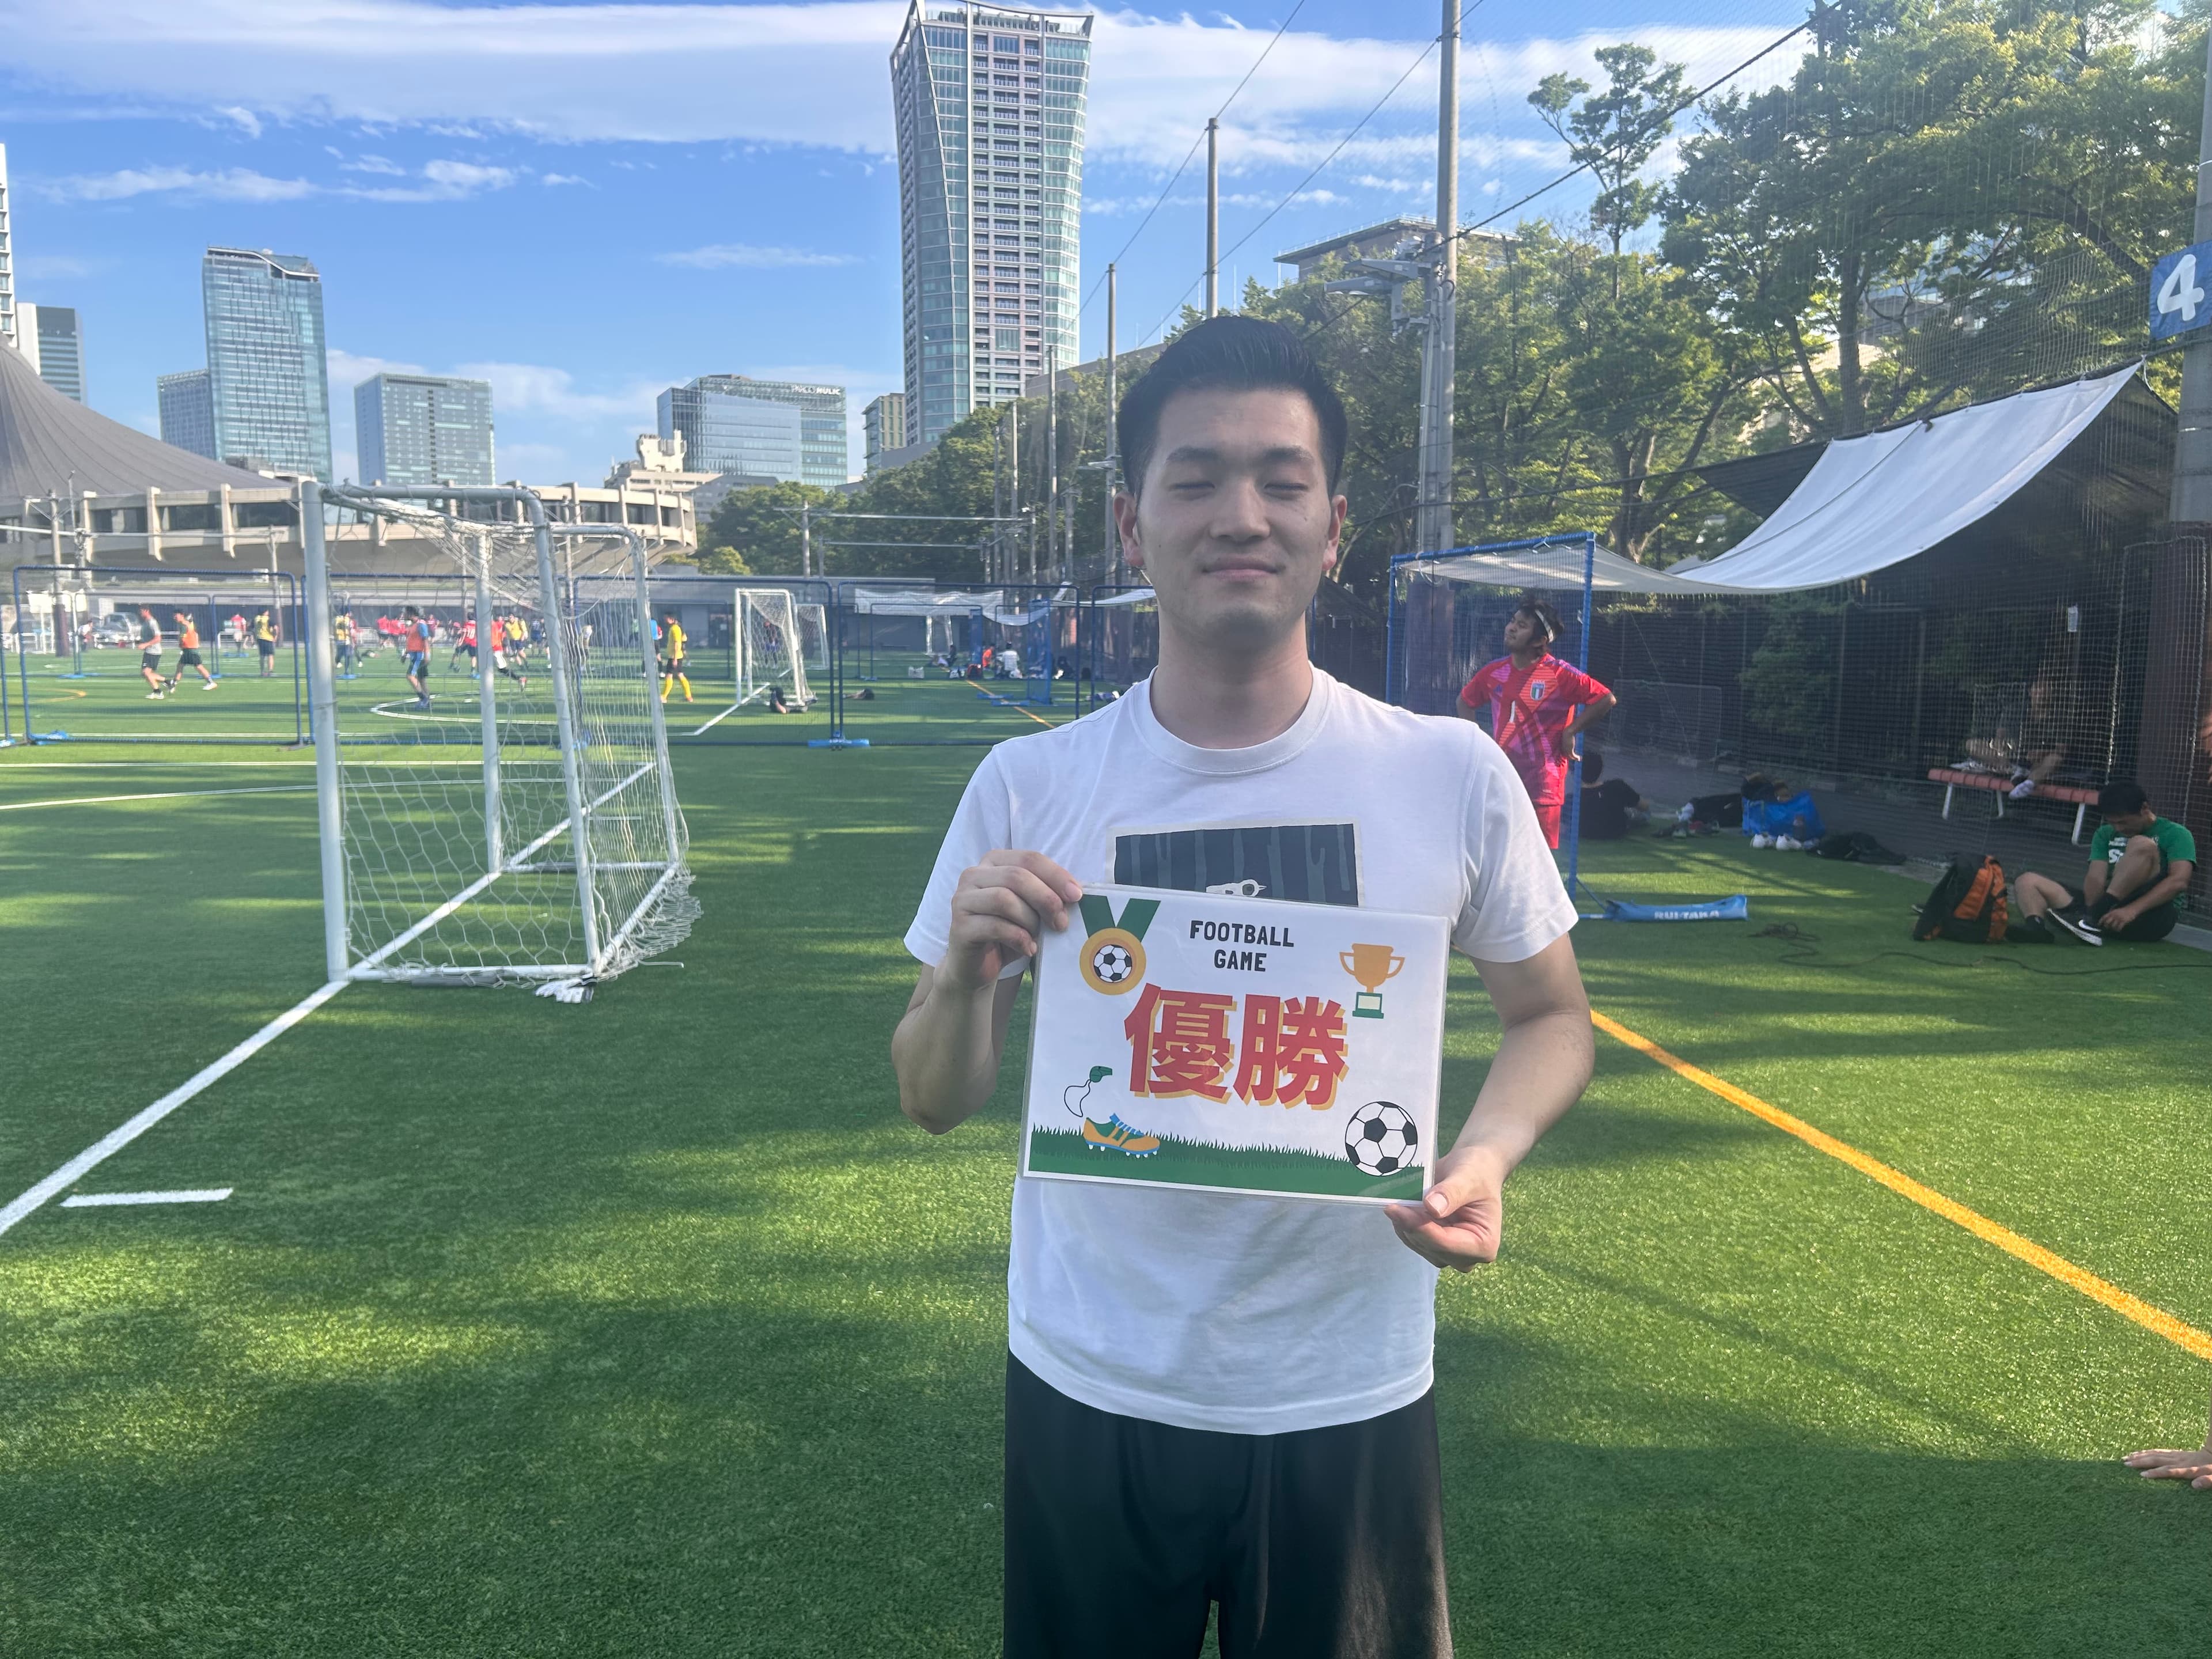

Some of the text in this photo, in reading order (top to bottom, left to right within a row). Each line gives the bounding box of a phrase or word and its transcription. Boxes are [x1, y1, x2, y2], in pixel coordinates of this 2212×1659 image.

[2157, 253, 2205, 321] 4
[1190, 920, 1294, 948] FOOTBALL
[1214, 949, 1267, 972] GAME
[1124, 982, 1349, 1111] 優勝
